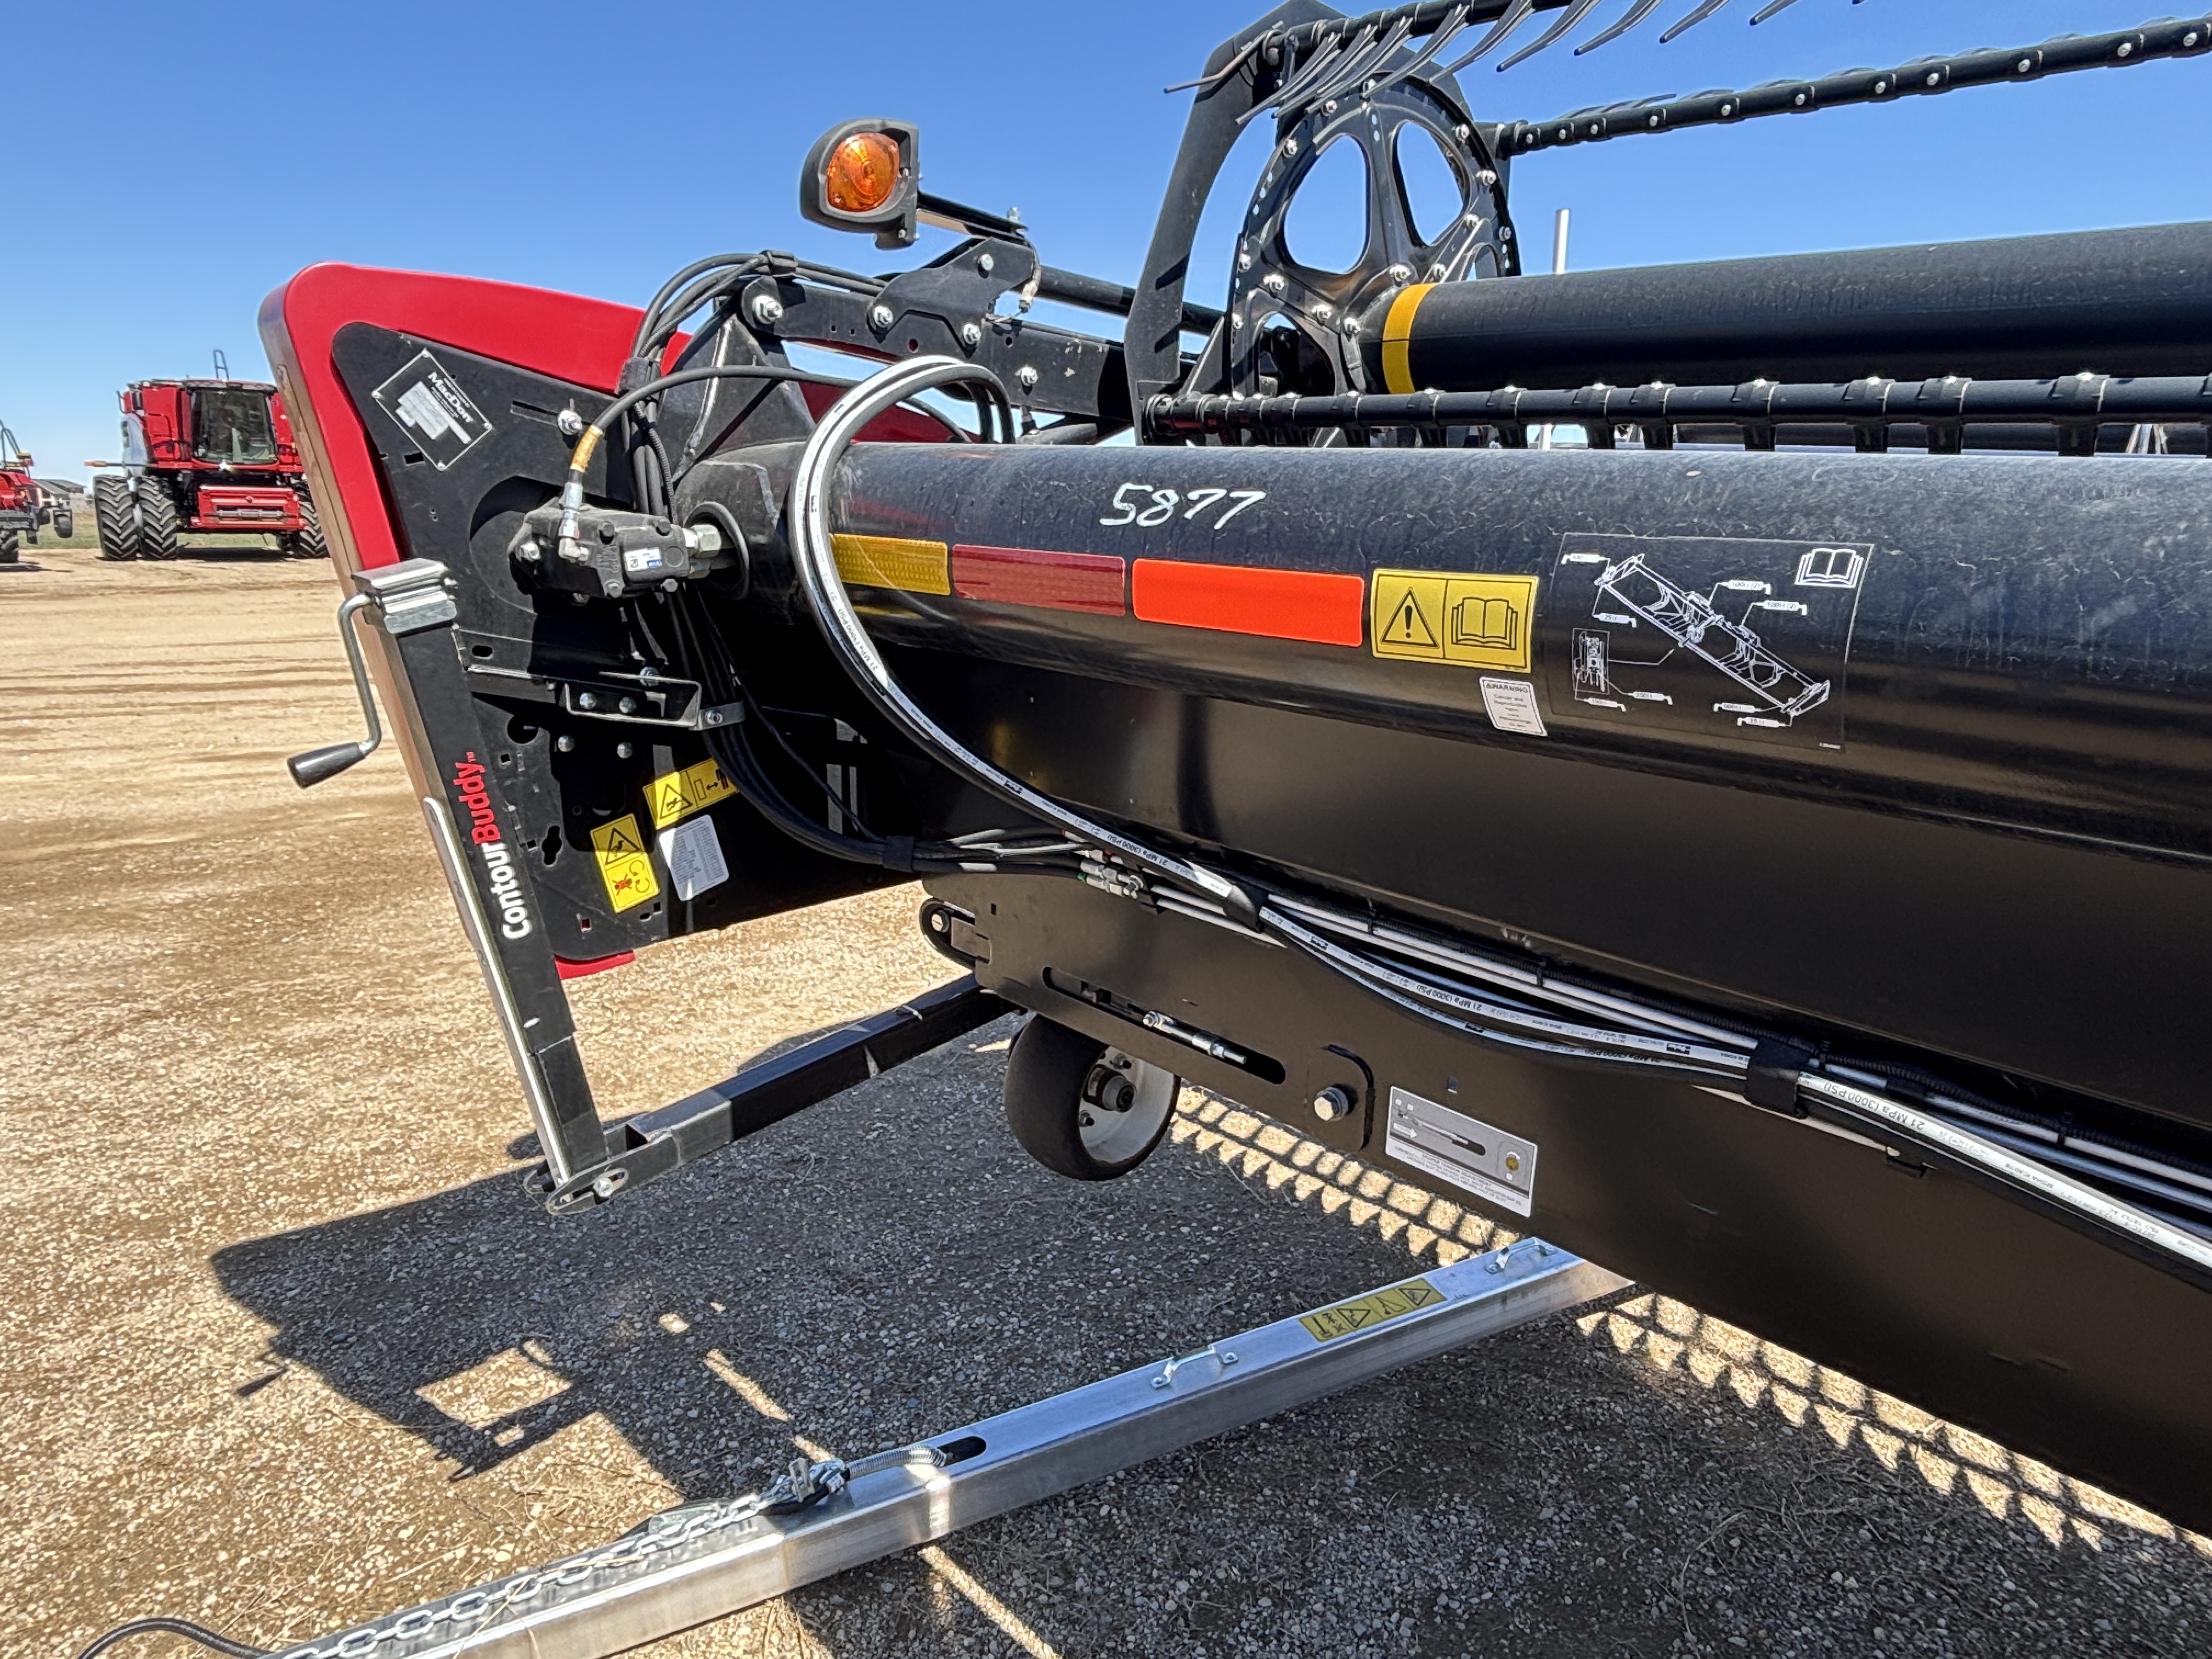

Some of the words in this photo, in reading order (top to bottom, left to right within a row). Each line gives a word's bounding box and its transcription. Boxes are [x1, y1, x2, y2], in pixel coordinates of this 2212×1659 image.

[428, 372, 473, 422] MacDon
[1099, 483, 1266, 530] 5877
[1142, 850, 1159, 861] MPa
[1454, 996, 1472, 1008] MPa
[1880, 1105, 1909, 1124] MPa
[1910, 1118, 1926, 1132] 21
